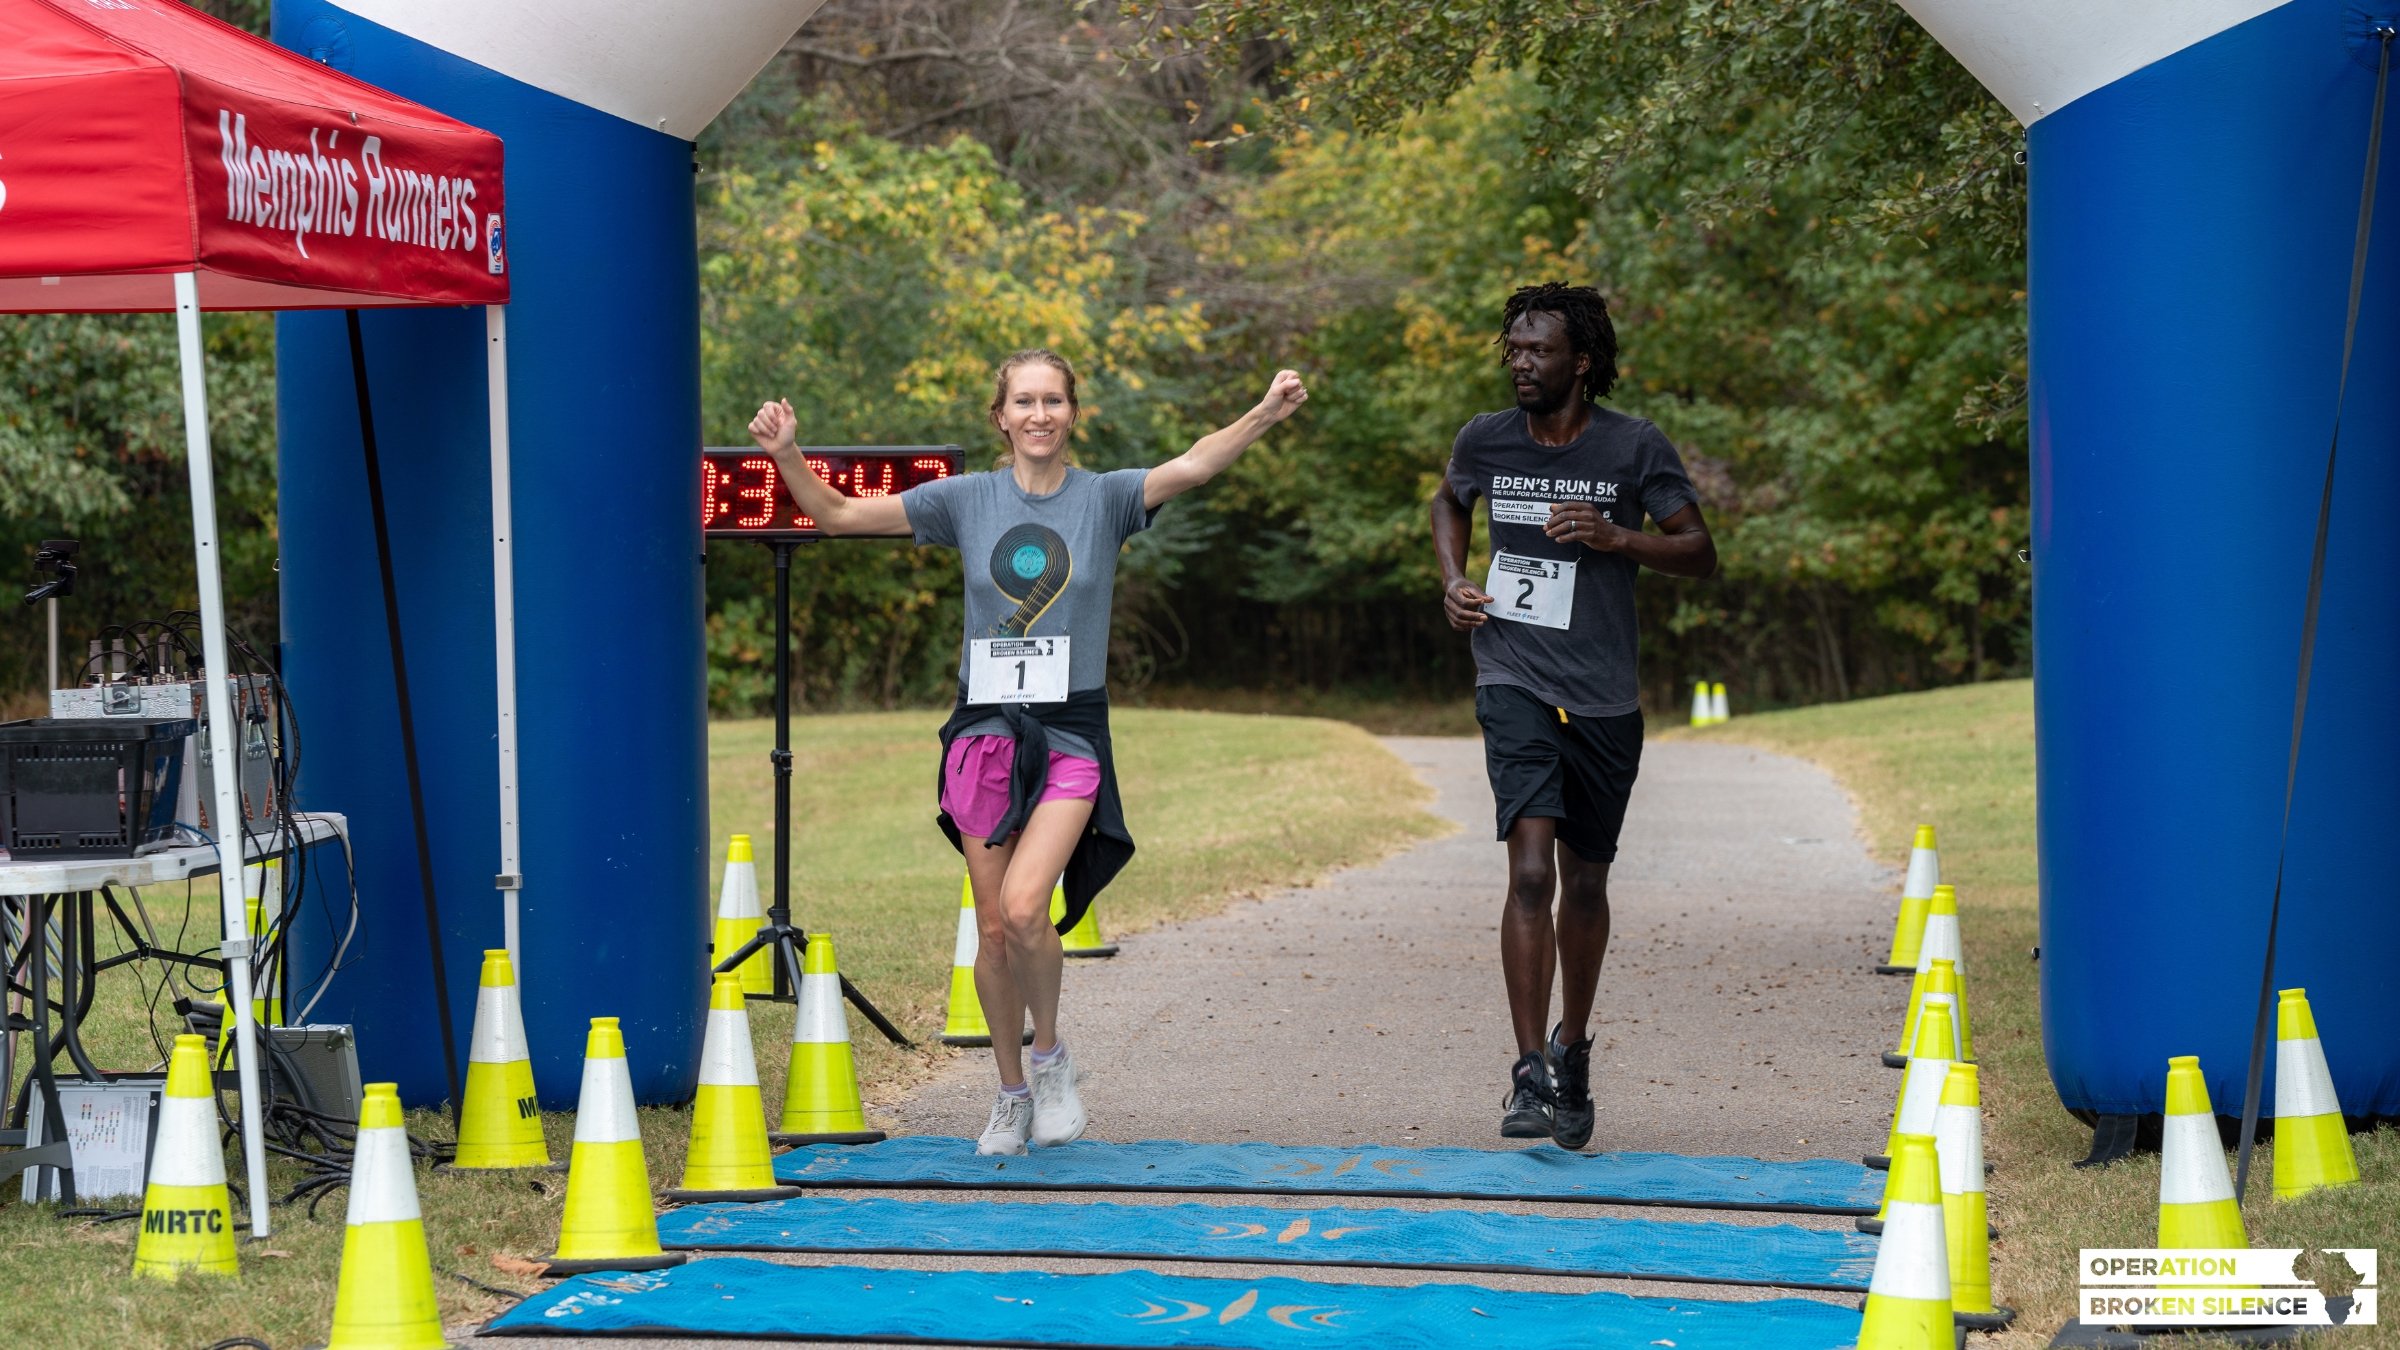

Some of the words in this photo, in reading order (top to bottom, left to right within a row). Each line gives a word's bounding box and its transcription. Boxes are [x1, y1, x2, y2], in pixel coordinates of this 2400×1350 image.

[219, 109, 359, 259] Memphis
[362, 136, 477, 251] Runners
[1492, 476, 1550, 492] EDEN'S
[1555, 479, 1591, 494] RUN
[1595, 482, 1619, 497] 5K
[1493, 501, 1534, 510] OPERATION
[1493, 513, 1520, 522] BROKEN
[1522, 515, 1551, 523] SILENC
[1499, 556, 1531, 566] OPERATION
[1499, 564, 1521, 573] BROKEN
[1522, 567, 1545, 576] SILENCE
[1515, 577, 1535, 611] 2
[1014, 660, 1026, 690] 1
[145, 1208, 223, 1235] MRTC
